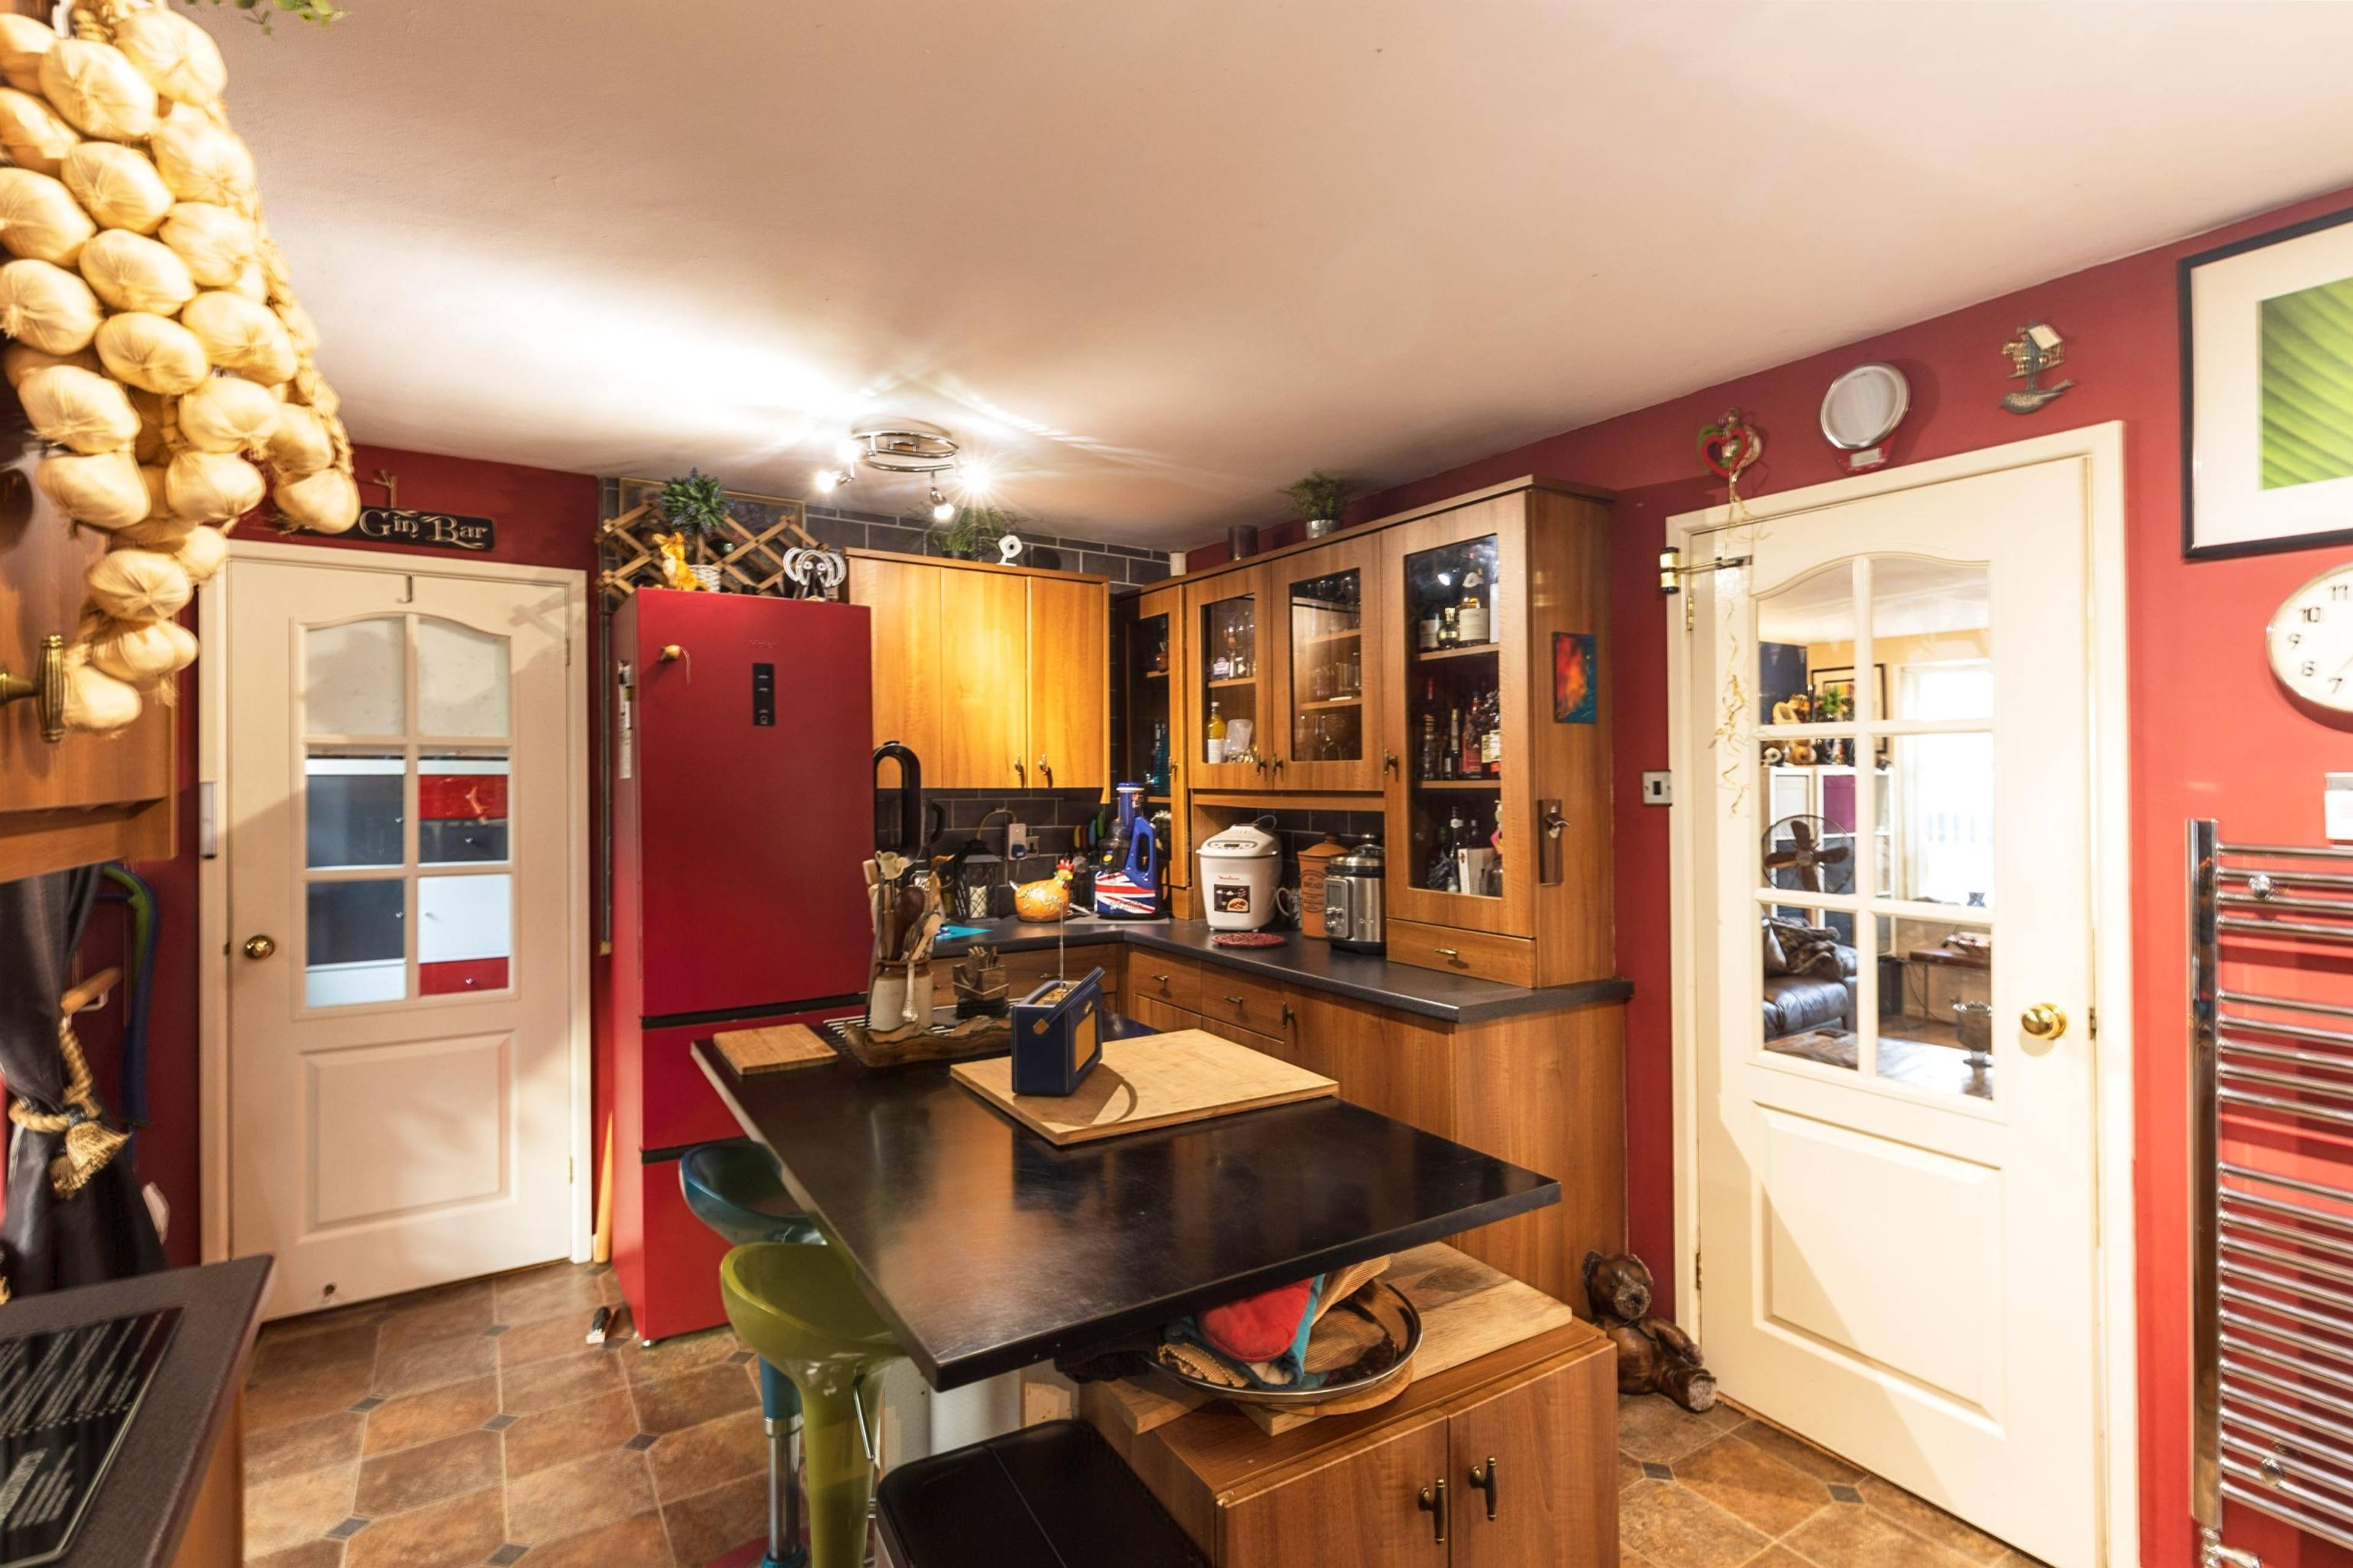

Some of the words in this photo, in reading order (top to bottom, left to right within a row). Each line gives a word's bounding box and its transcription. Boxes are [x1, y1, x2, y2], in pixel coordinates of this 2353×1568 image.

[359, 509, 420, 539] Gin
[420, 515, 488, 549] Bar
[2329, 585, 2348, 601] 11
[2300, 607, 2321, 623] 10
[2289, 634, 2301, 650] 9
[2328, 677, 2343, 694] 7
